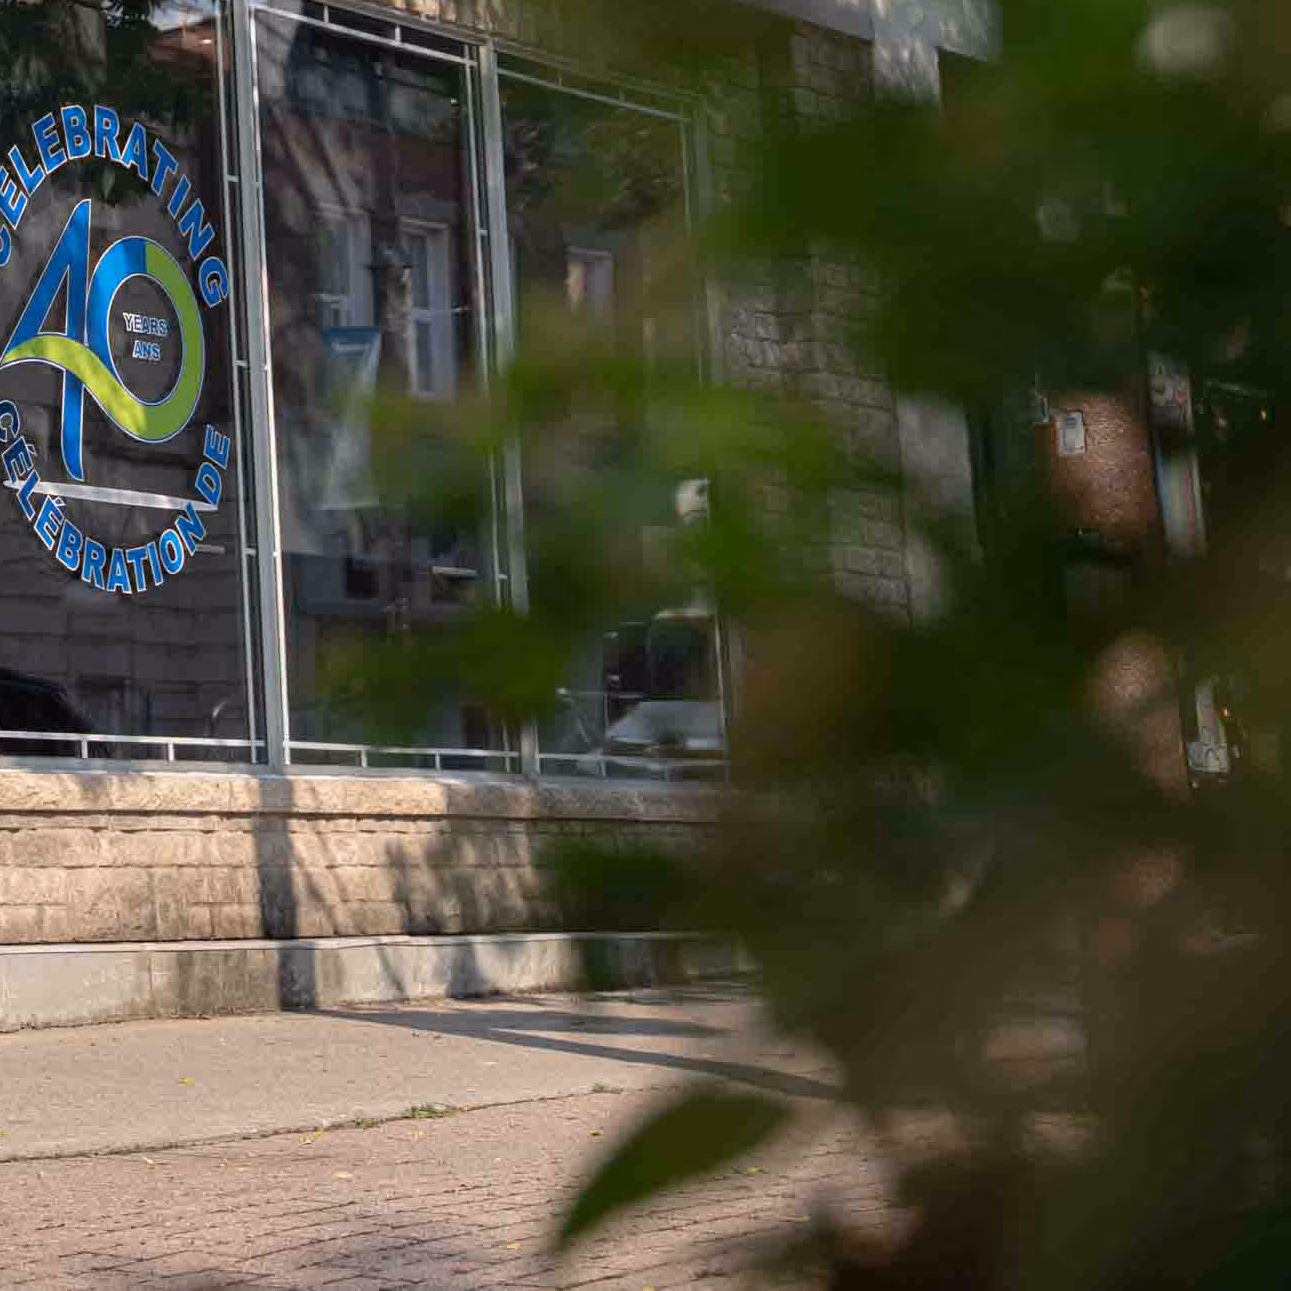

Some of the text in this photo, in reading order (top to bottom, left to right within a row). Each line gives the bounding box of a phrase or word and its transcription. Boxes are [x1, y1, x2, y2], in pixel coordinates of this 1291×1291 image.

[122, 312, 169, 336] YEARS
[132, 338, 161, 361] ANS
[194, 423, 232, 506] DE
